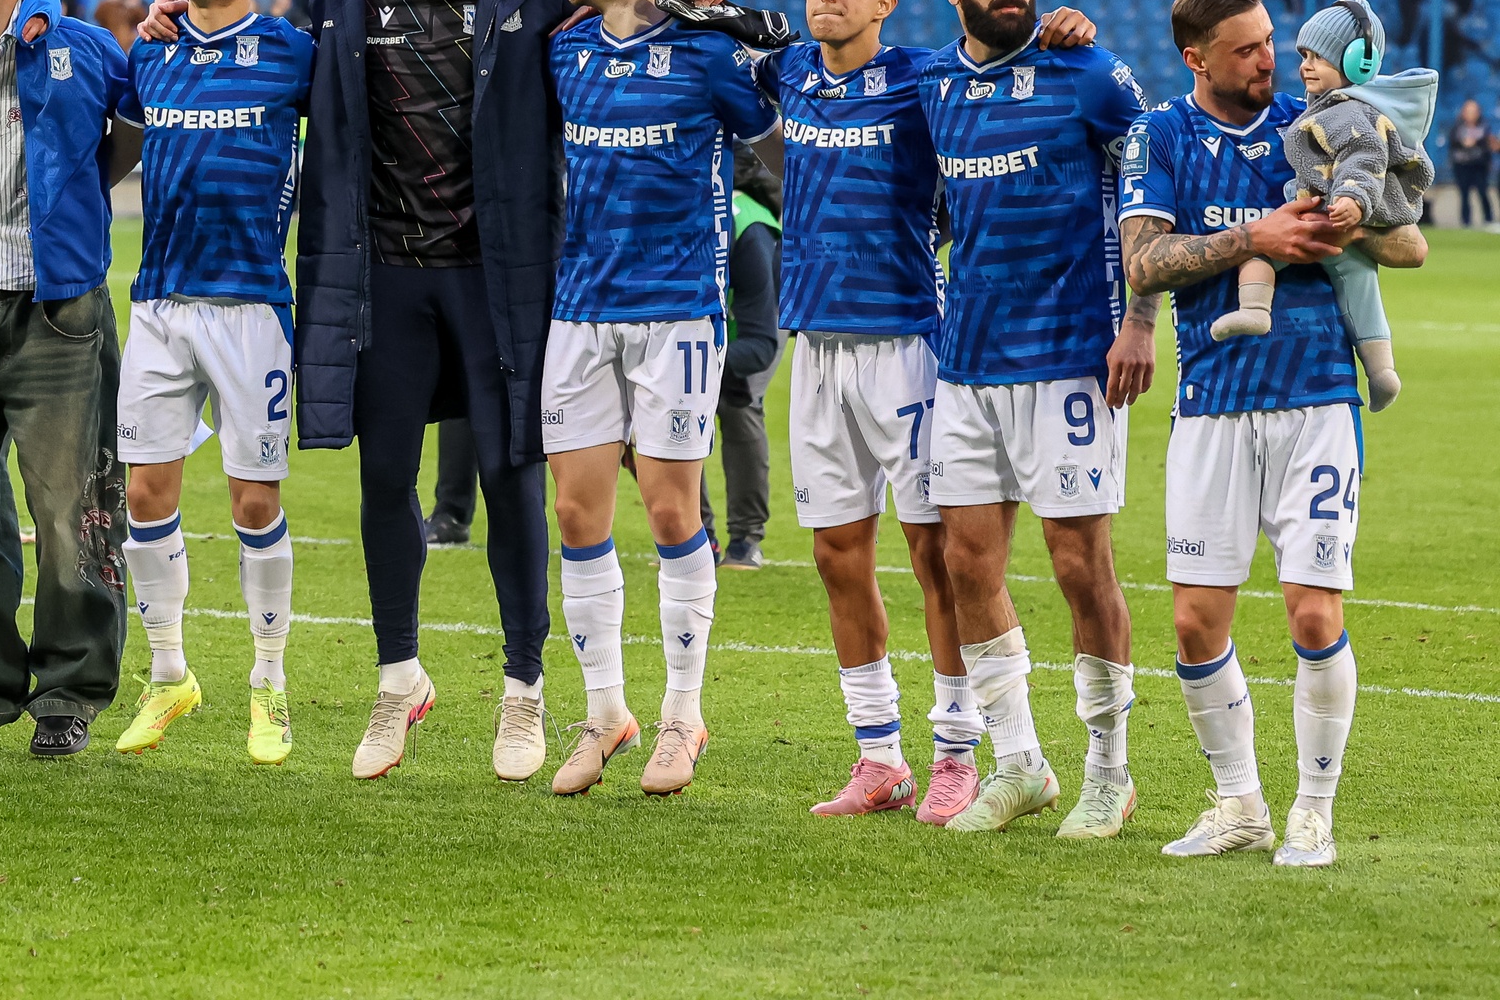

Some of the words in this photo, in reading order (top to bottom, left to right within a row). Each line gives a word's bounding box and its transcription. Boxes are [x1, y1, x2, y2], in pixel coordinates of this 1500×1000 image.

[366, 35, 406, 45] SUPERBET
[196, 52, 217, 62] LOTTO
[610, 65, 630, 75] LOTTO
[971, 86, 990, 96] LOTTO
[144, 106, 266, 130] SUPERBET
[564, 121, 678, 148] SUPERBET
[783, 118, 895, 148] SUPERBET
[1242, 145, 1264, 158] LOTTO
[677, 341, 708, 394] 11
[264, 369, 288, 422] 2
[1063, 392, 1096, 447] 9
[1309, 464, 1357, 524] 24
